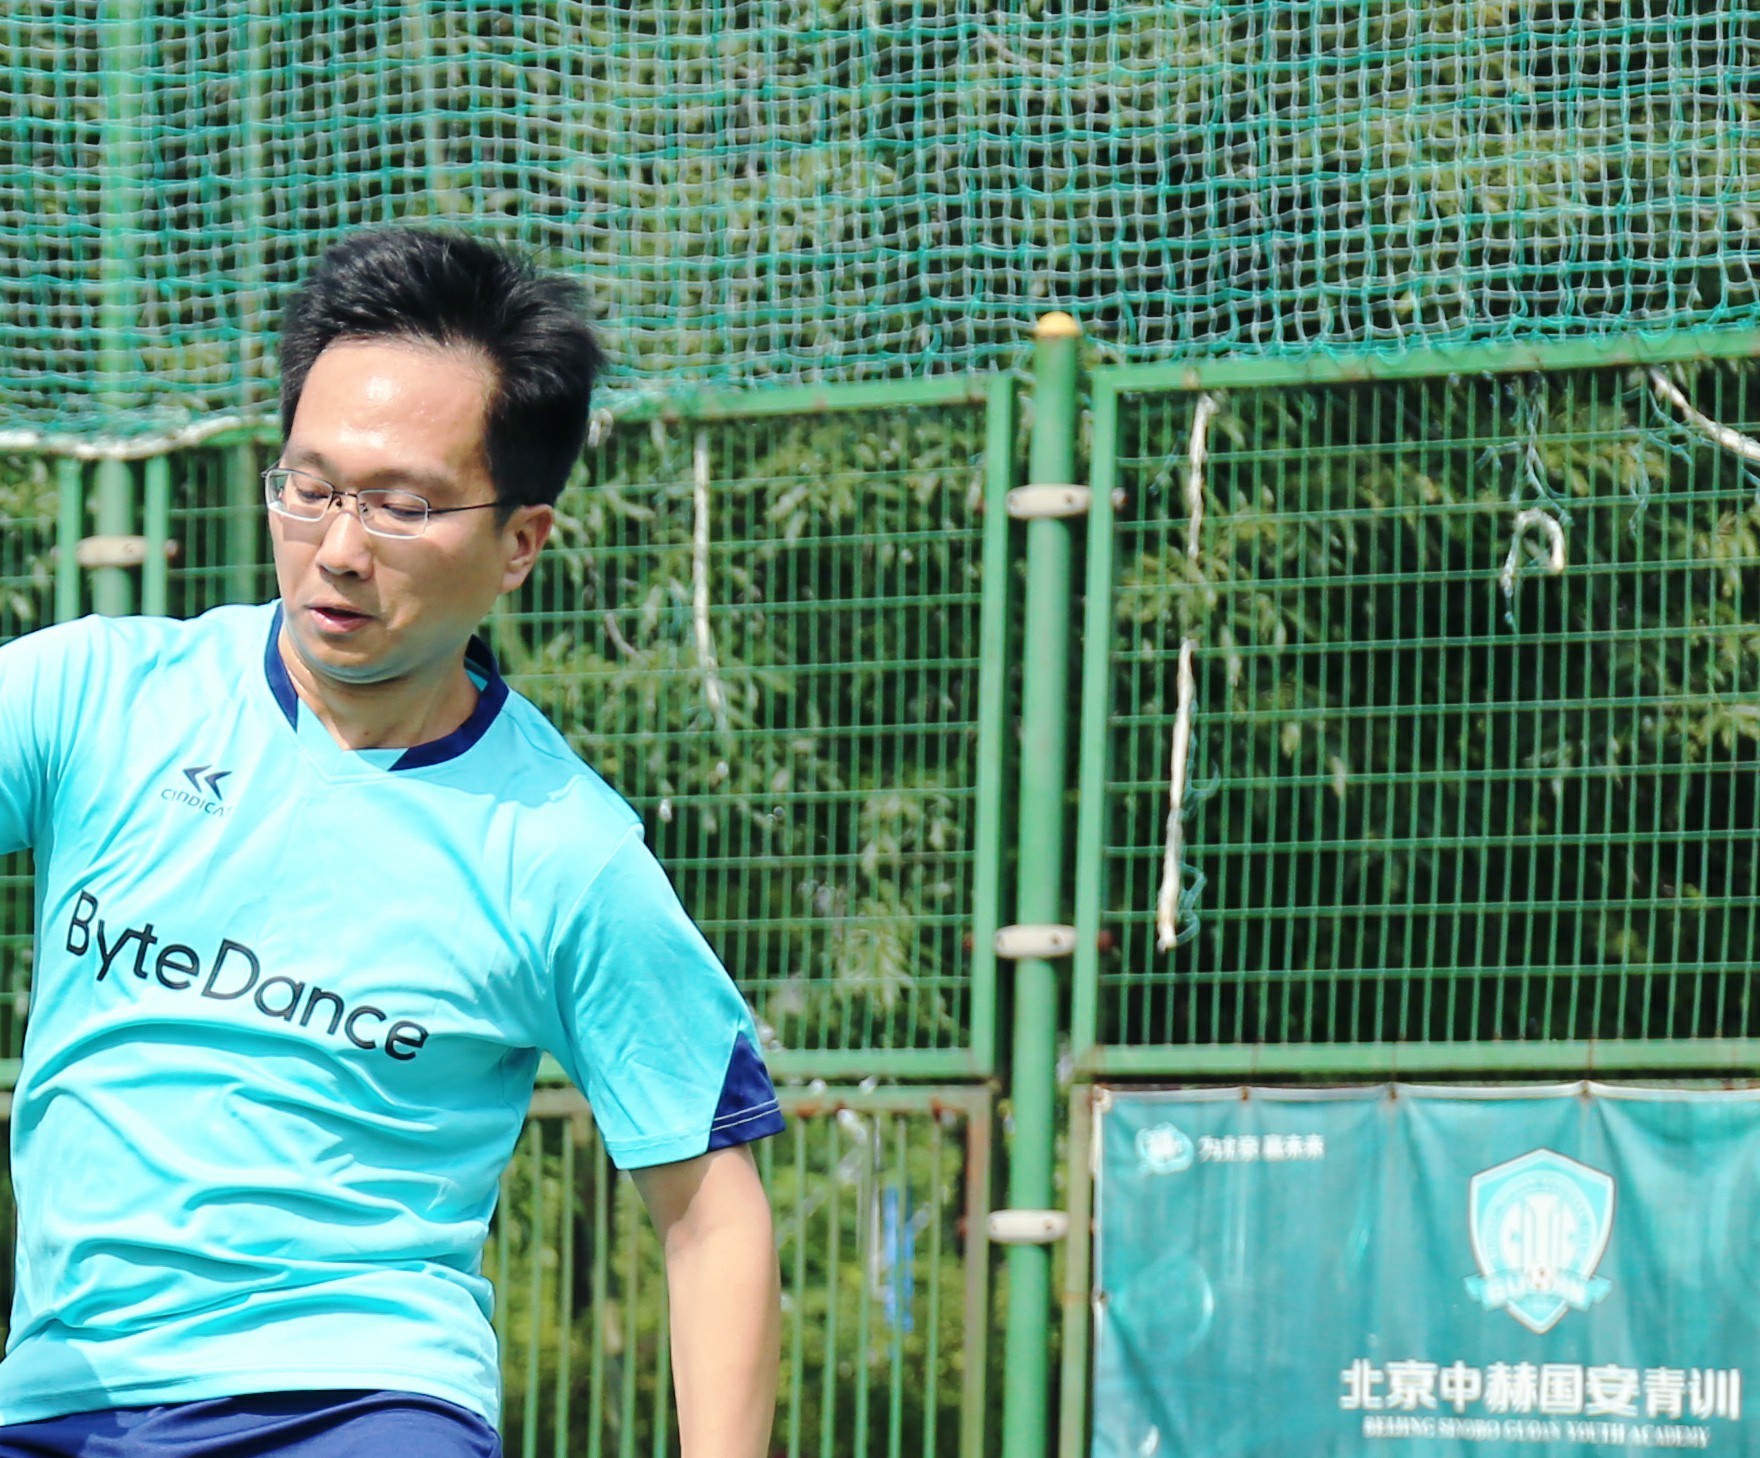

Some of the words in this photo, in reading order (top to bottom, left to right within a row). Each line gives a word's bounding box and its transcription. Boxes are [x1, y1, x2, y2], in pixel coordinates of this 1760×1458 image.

[161, 788, 233, 817] CNDICA
[66, 889, 429, 1060] ByteDance
[1339, 1357, 1741, 1421] 北京中赫国安青训
